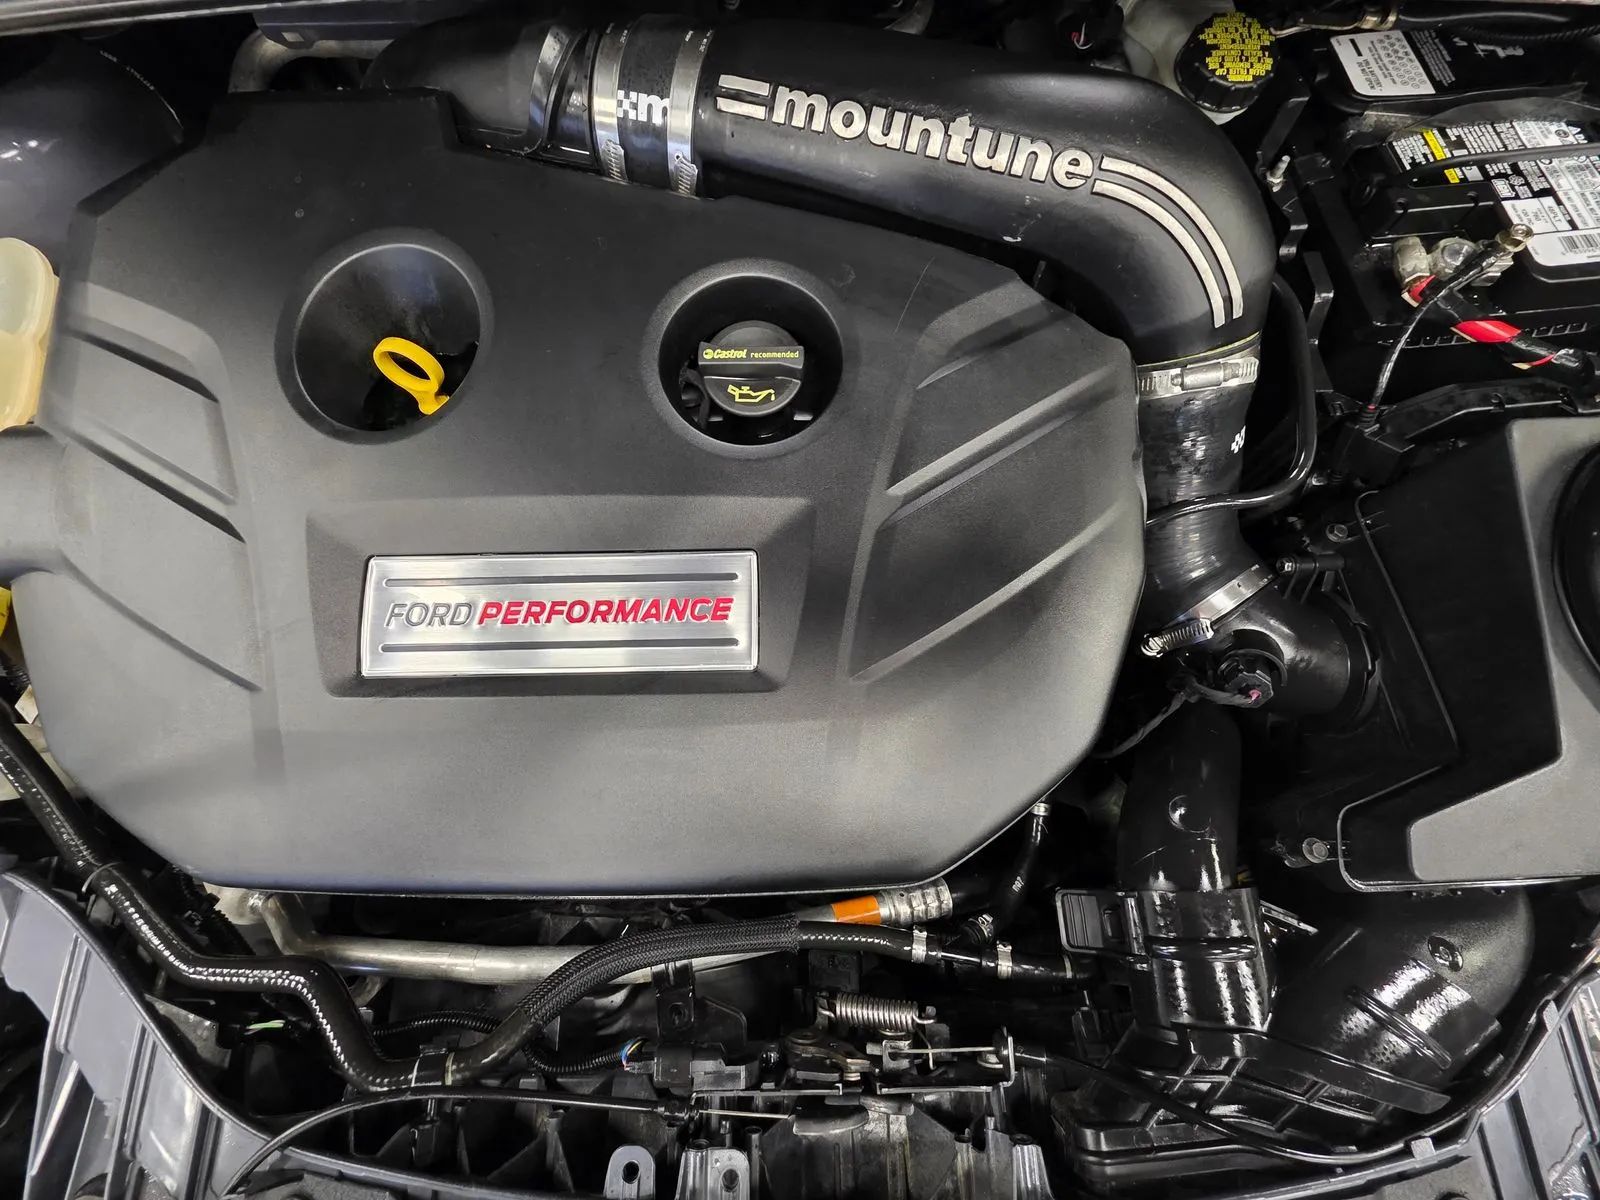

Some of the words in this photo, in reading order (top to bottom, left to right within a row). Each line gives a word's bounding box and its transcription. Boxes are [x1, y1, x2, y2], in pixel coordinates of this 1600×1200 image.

[1215, 68, 1227, 76] CAP
[1249, 68, 1266, 76] CLEAN
[771, 86, 1094, 190] mountune
[714, 349, 747, 359] Castrol
[384, 602, 473, 627] FORD
[477, 597, 735, 626] PERFORMANCE
